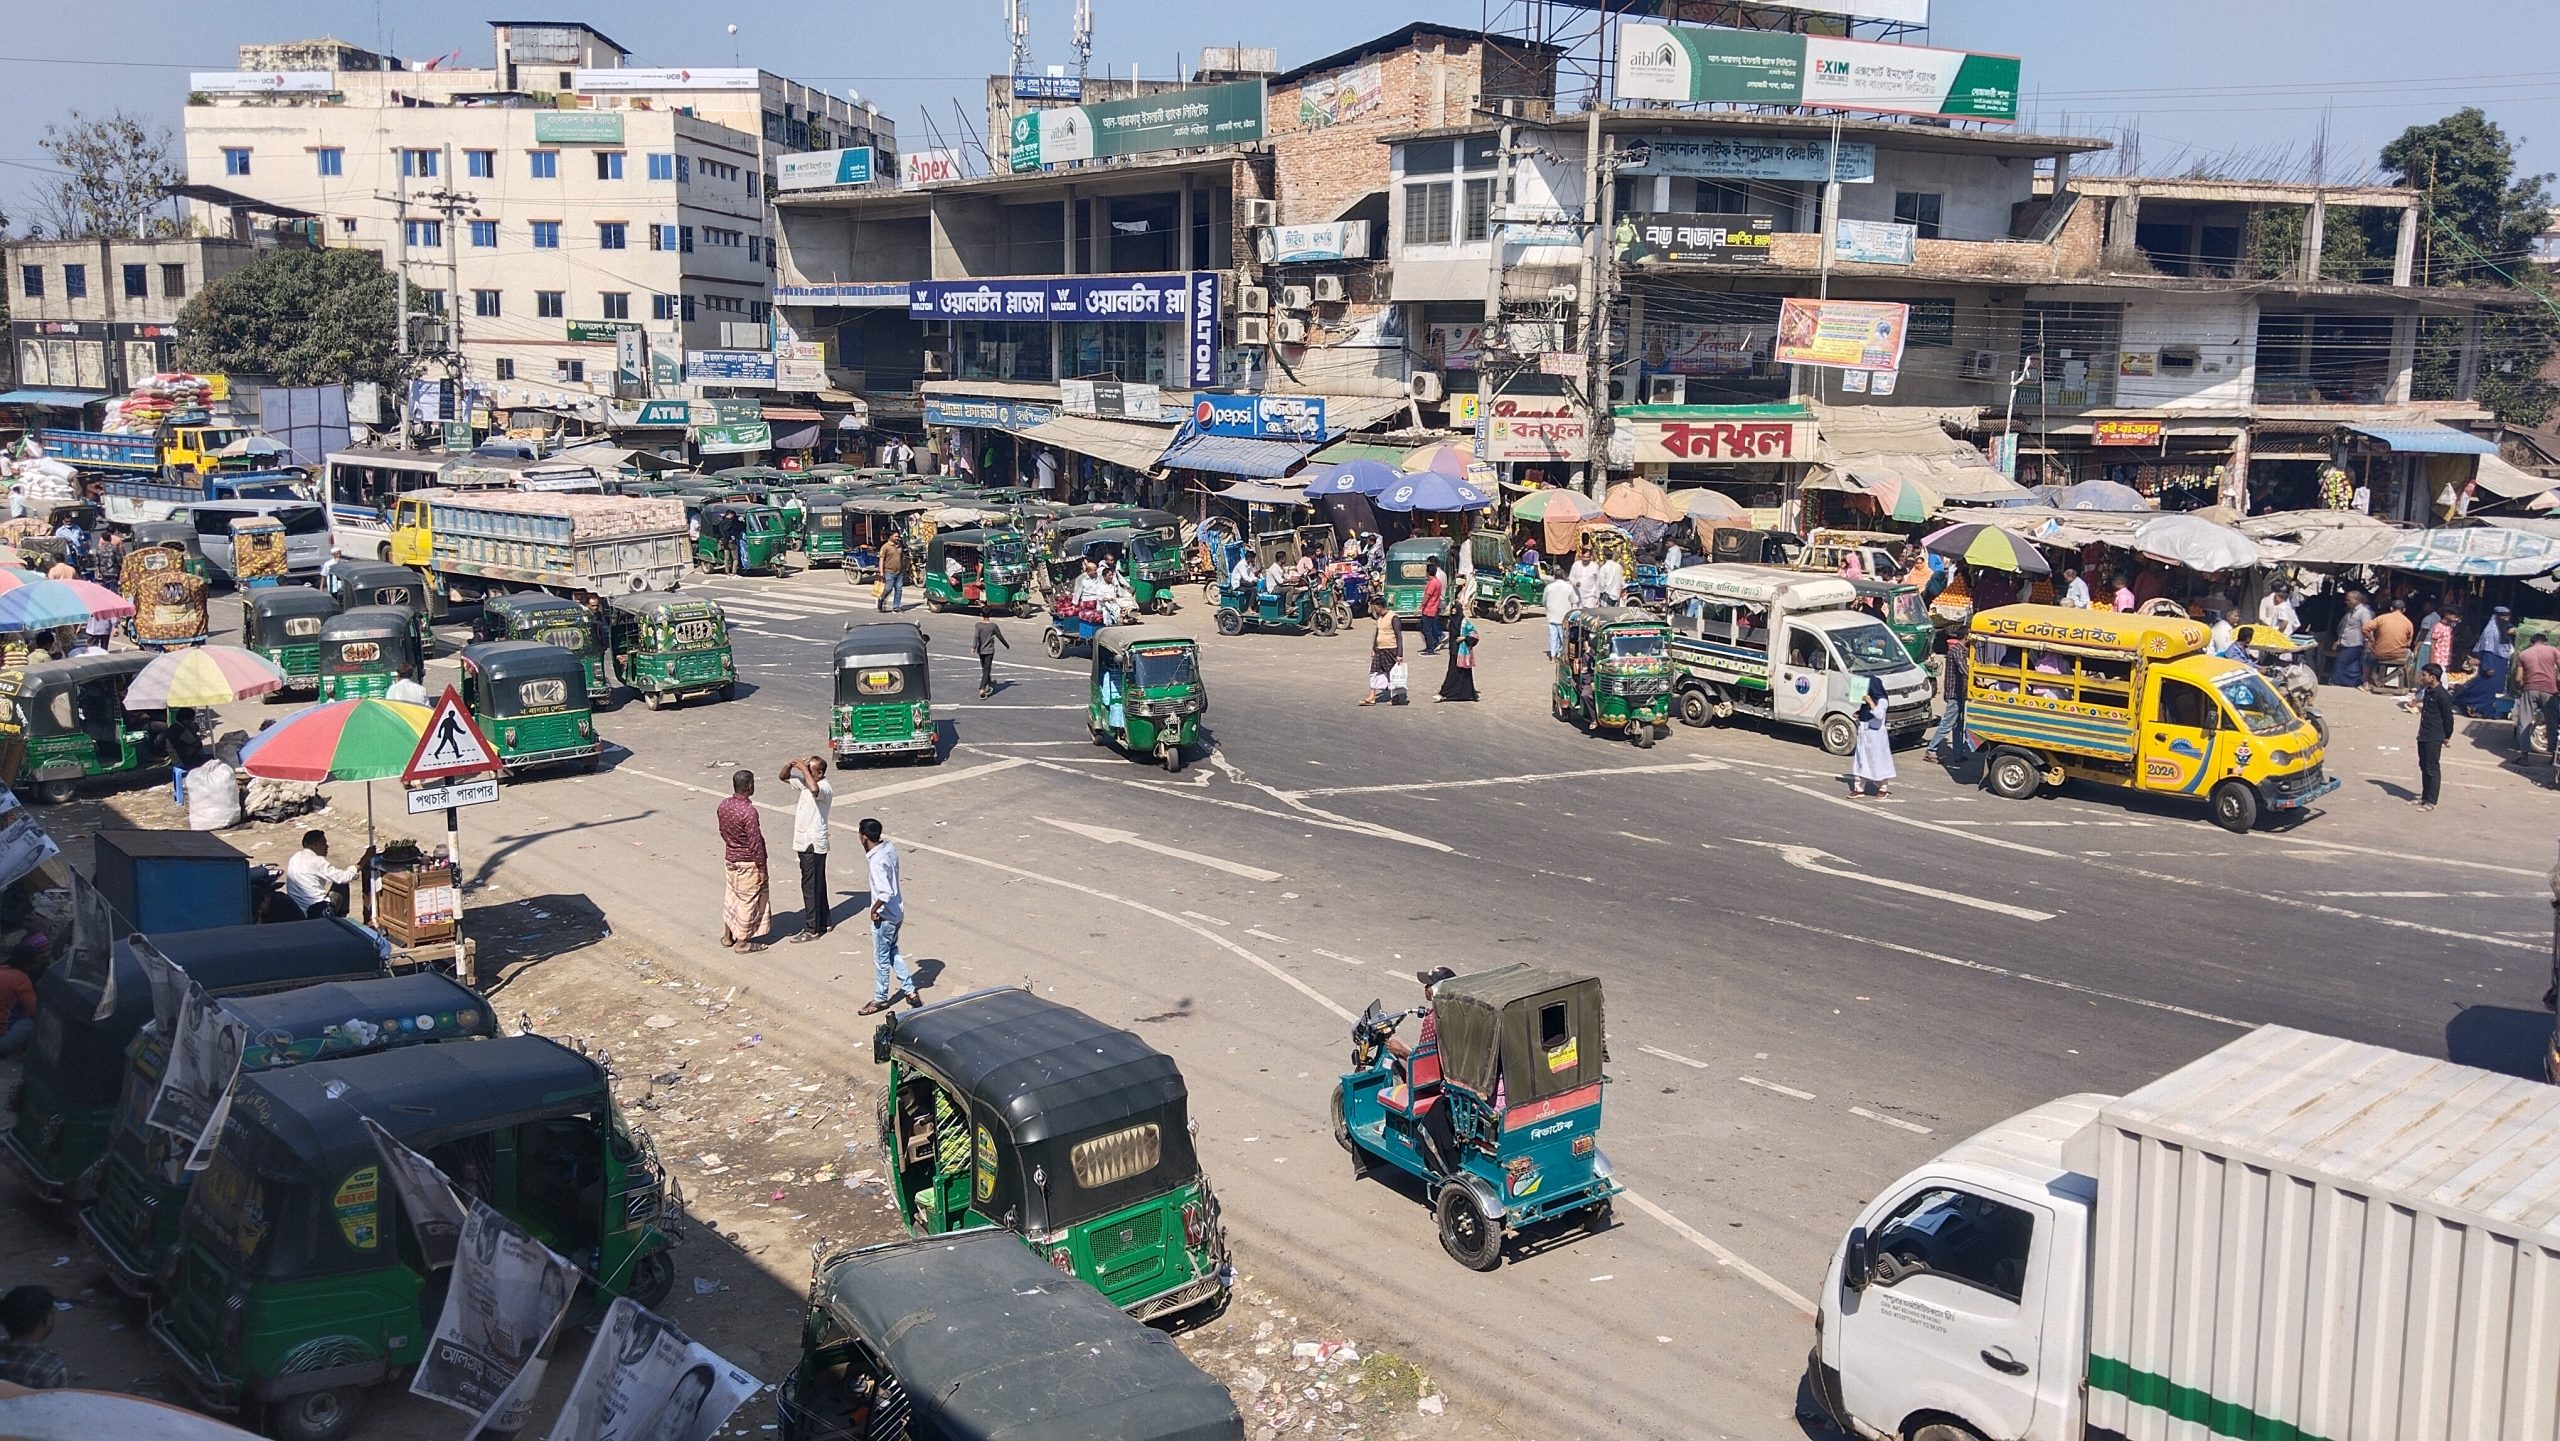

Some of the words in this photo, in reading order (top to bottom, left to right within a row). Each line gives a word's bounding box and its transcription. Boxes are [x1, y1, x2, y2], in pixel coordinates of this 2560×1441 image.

[1630, 52, 1655, 67] aibl
[1816, 60, 1849, 75] EXIM
[1654, 141, 1699, 157] ন্যাশনাল
[1701, 141, 1731, 156] লাইফ
[908, 155, 949, 183] Apex
[1646, 226, 1673, 249] বড়
[1677, 227, 1727, 250] বাজার
[940, 285, 1002, 315] ওয়ালটন
[1004, 291, 1045, 314] প্লাজা
[1051, 303, 1076, 311] WALTON
[1085, 283, 1160, 316] ওয়ালটন
[1197, 279, 1213, 382] WALTON
[649, 407, 685, 419] ATM
[1215, 406, 1253, 427] pepsi
[1511, 423, 1584, 441] বনফুল
[2118, 425, 2158, 434] বাজার
[1660, 423, 1793, 459] বনফুল
[416, 788, 450, 806] পথচারী
[457, 785, 493, 801] পারাপার
